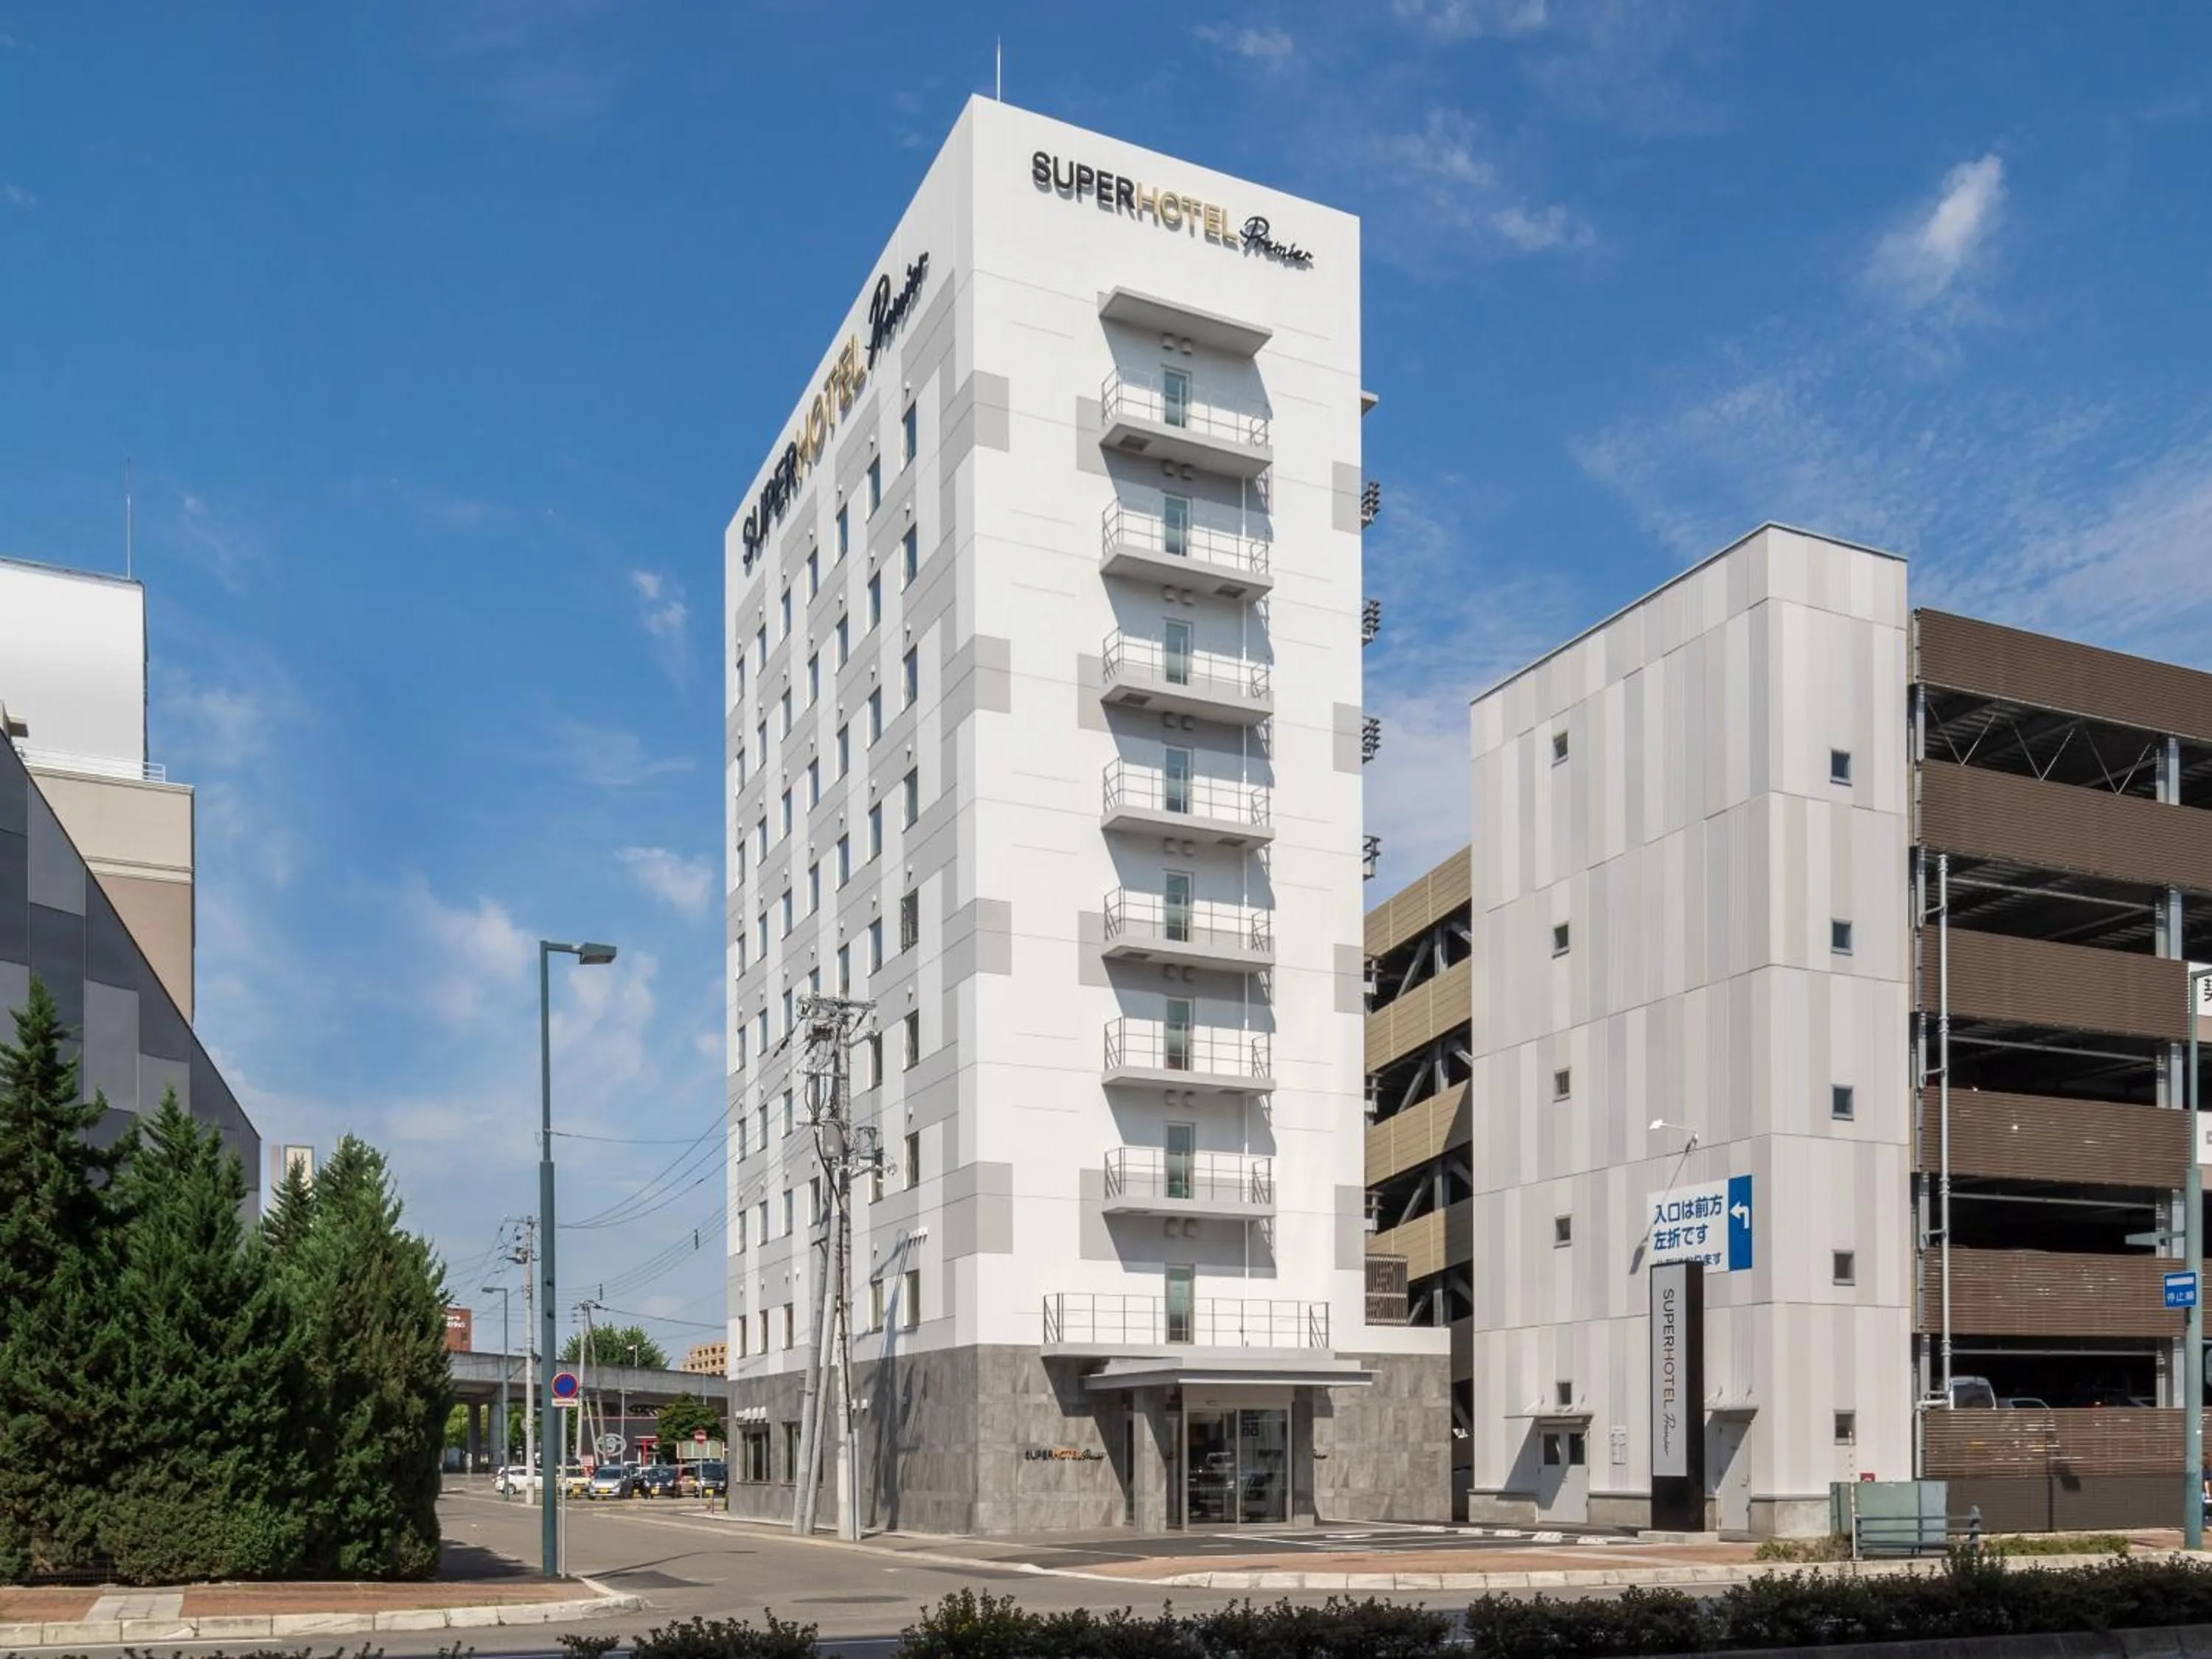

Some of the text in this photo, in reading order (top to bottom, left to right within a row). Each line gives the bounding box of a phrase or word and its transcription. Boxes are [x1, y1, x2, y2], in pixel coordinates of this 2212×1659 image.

[1032, 151, 1314, 262] SUPERHOTEL Premier
[1654, 1194, 1723, 1225] 入口は前方
[1654, 1222, 1708, 1251] 左折です
[1663, 1288, 1674, 1410] SUPERHOTEL
